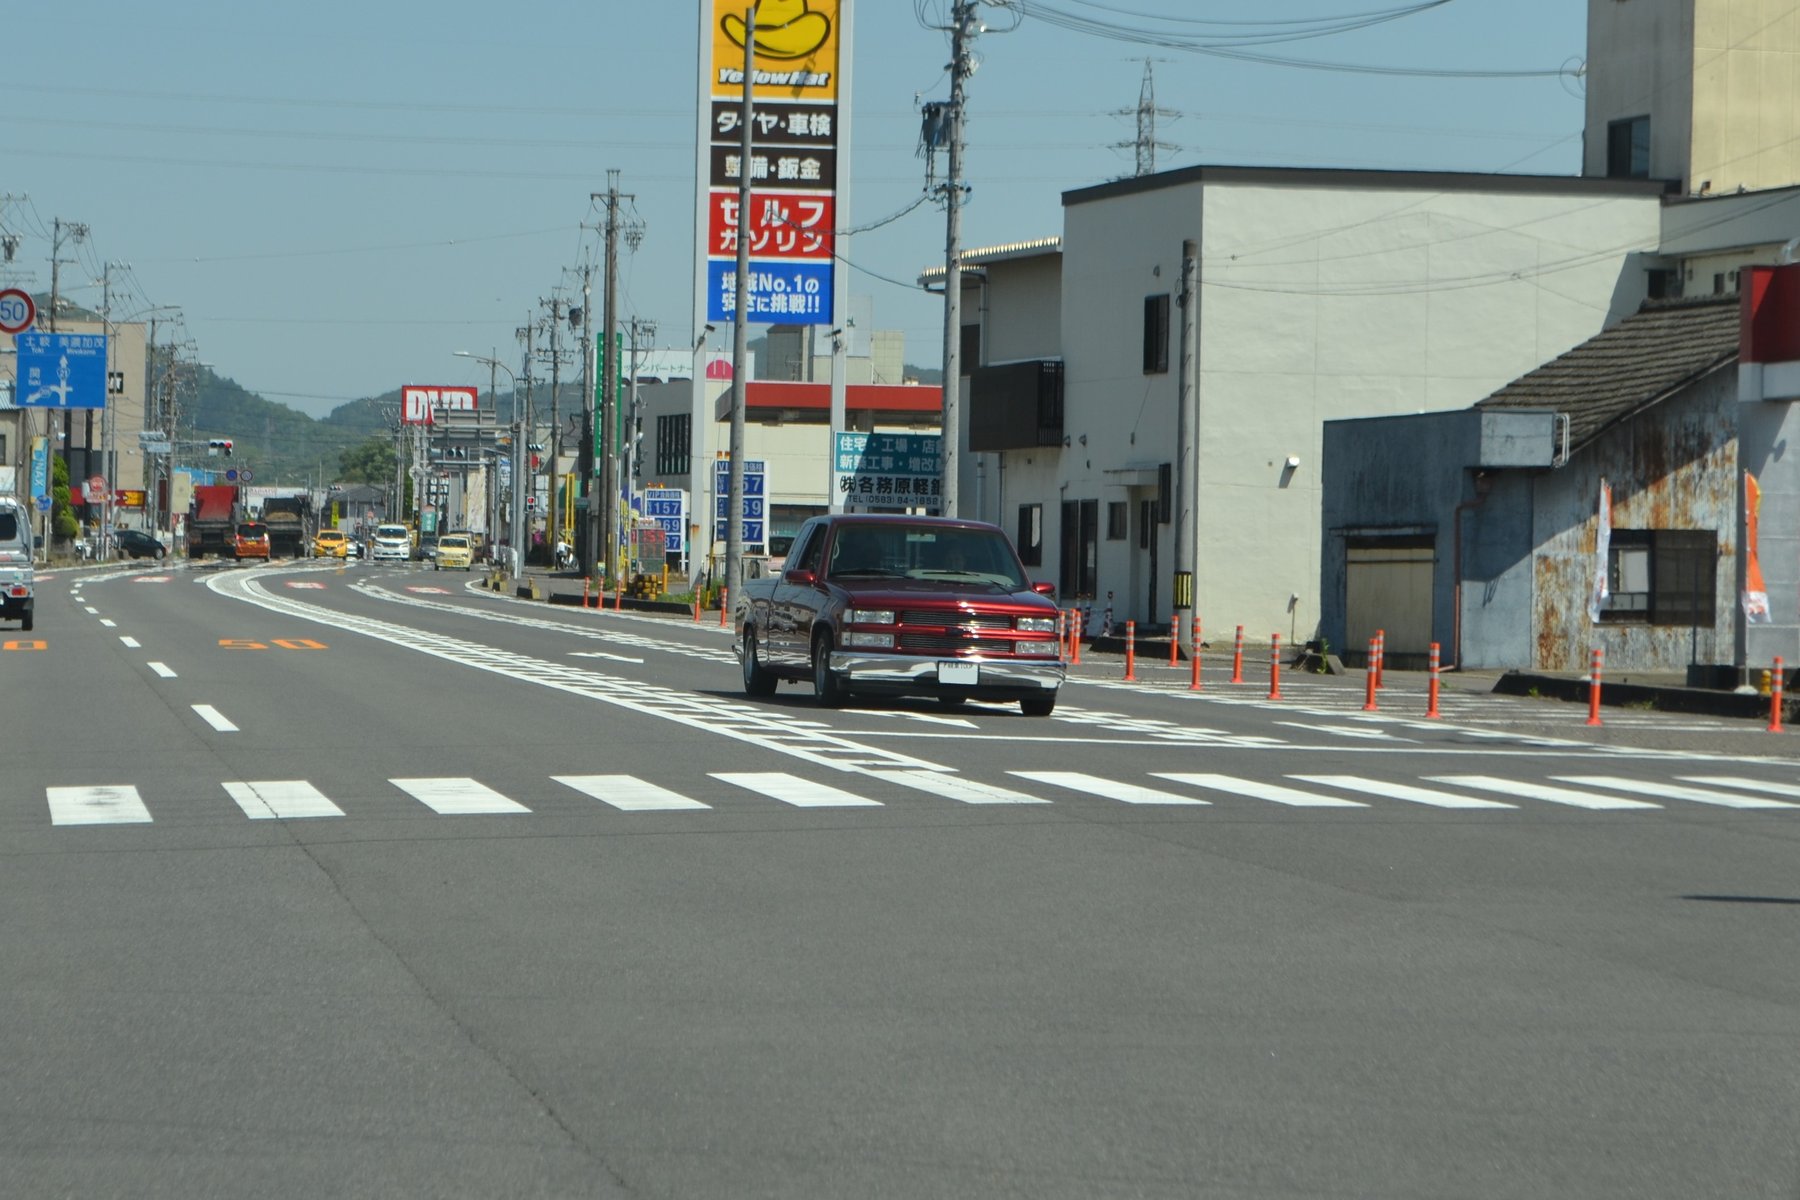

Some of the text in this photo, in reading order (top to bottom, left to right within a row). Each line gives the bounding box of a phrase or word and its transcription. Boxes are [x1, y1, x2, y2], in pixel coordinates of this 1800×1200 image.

[718, 68, 830, 87] YelowHat
[720, 198, 824, 228] セルフ
[720, 229, 823, 252] ガソリン
[0, 302, 25, 321] 50
[743, 477, 762, 492] 57
[654, 502, 680, 514] 157
[743, 500, 762, 515] 69
[663, 520, 680, 531] 69
[218, 639, 329, 649] 50
